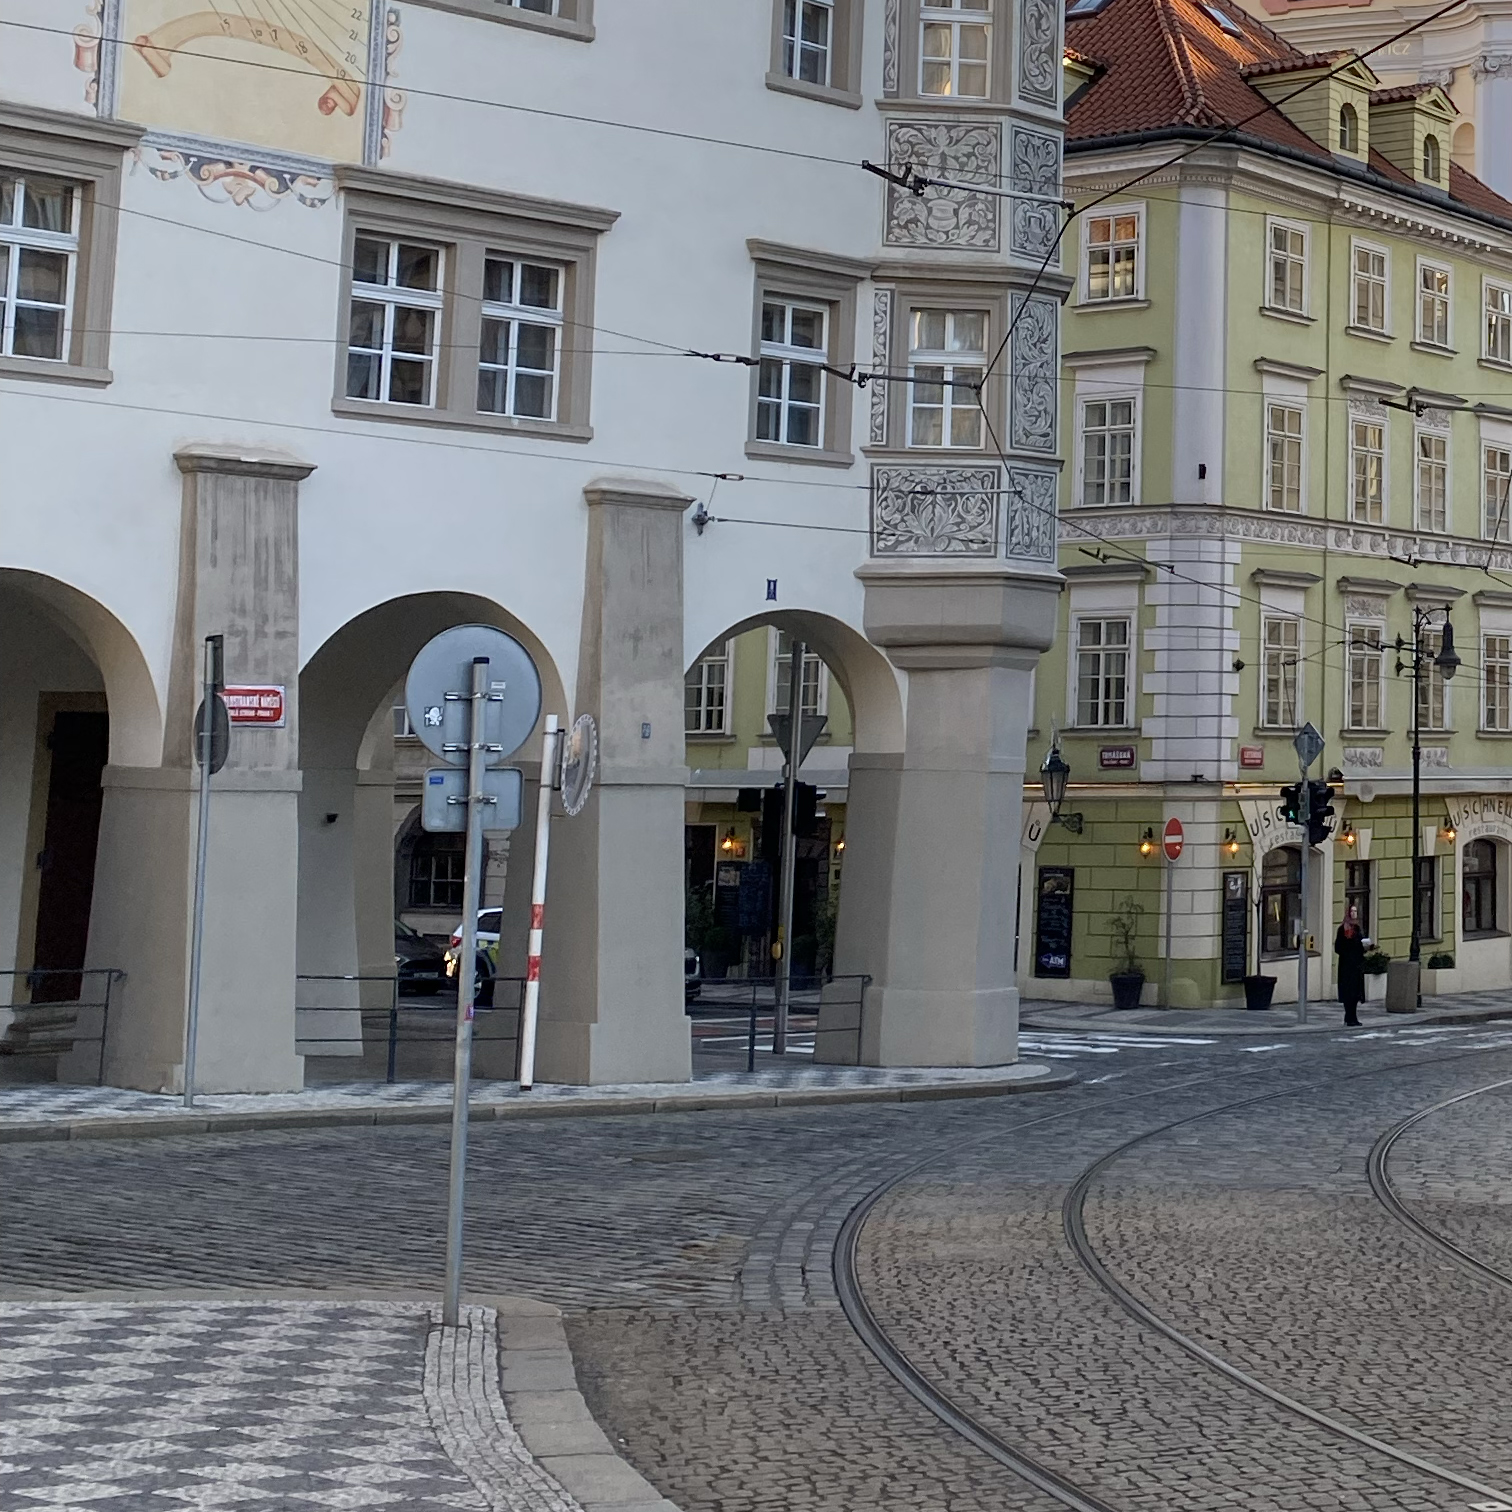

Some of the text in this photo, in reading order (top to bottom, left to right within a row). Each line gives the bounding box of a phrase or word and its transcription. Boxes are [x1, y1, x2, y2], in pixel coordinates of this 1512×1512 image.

[350, 8, 362, 21] 22
[348, 29, 359, 42] 21
[295, 41, 308, 55] 18
[344, 52, 357, 65] 20
[1050, 955, 1065, 966] ATM
